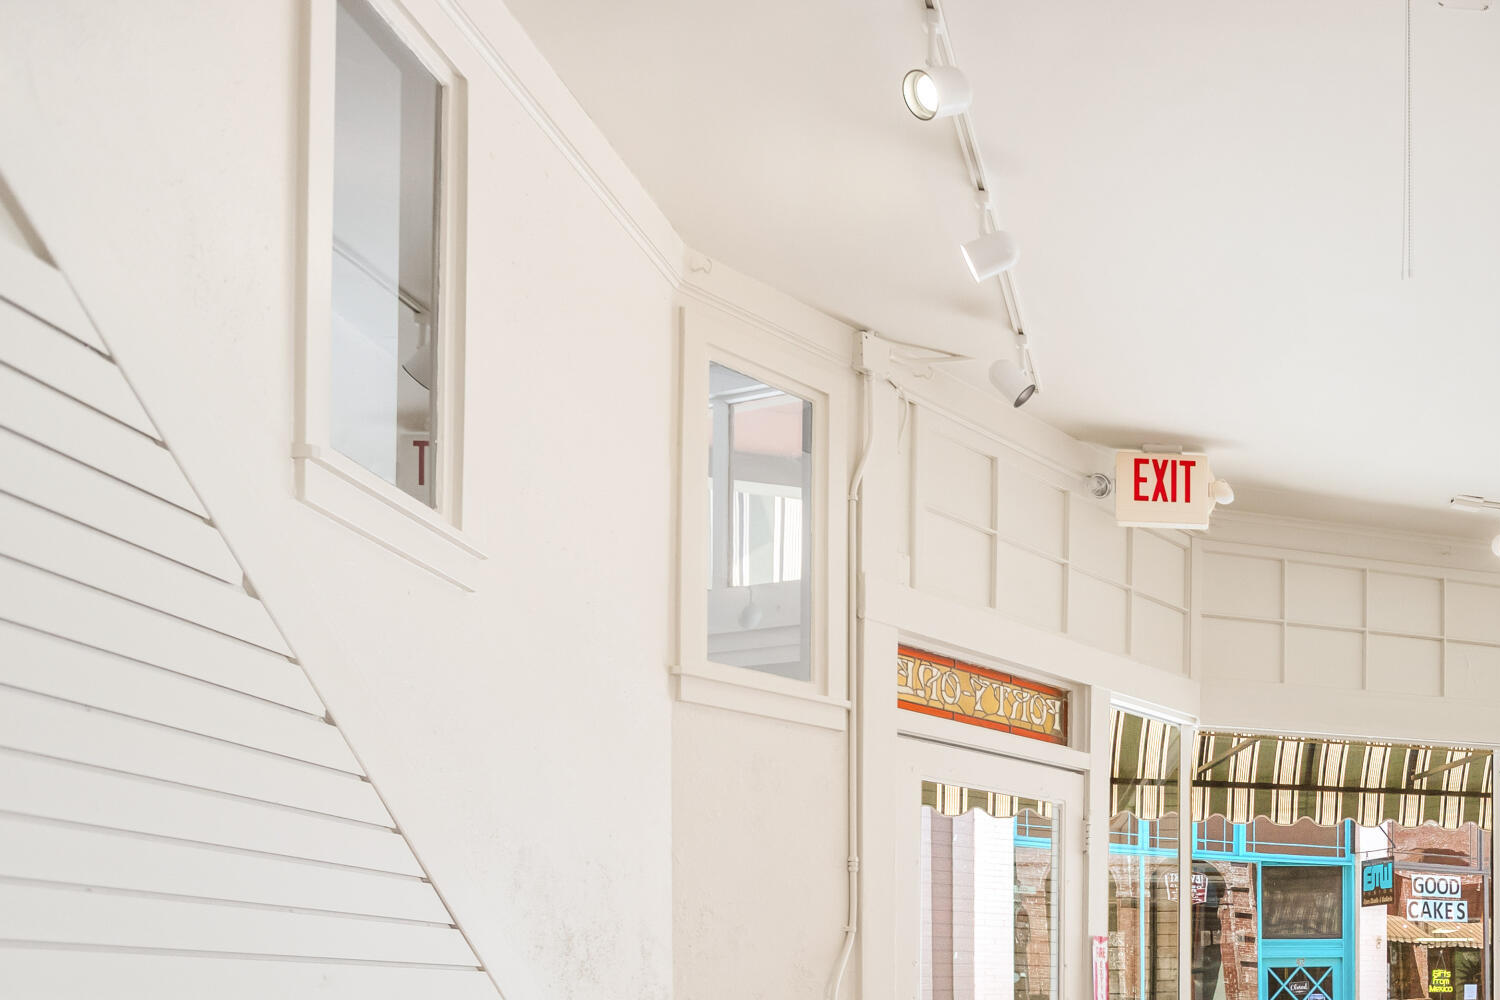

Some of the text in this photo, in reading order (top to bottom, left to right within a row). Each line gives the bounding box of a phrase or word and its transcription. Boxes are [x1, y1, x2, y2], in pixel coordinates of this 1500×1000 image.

[1134, 458, 1196, 503] EXIT
[1413, 876, 1460, 895] GOOD
[1408, 901, 1466, 920] CAKES
